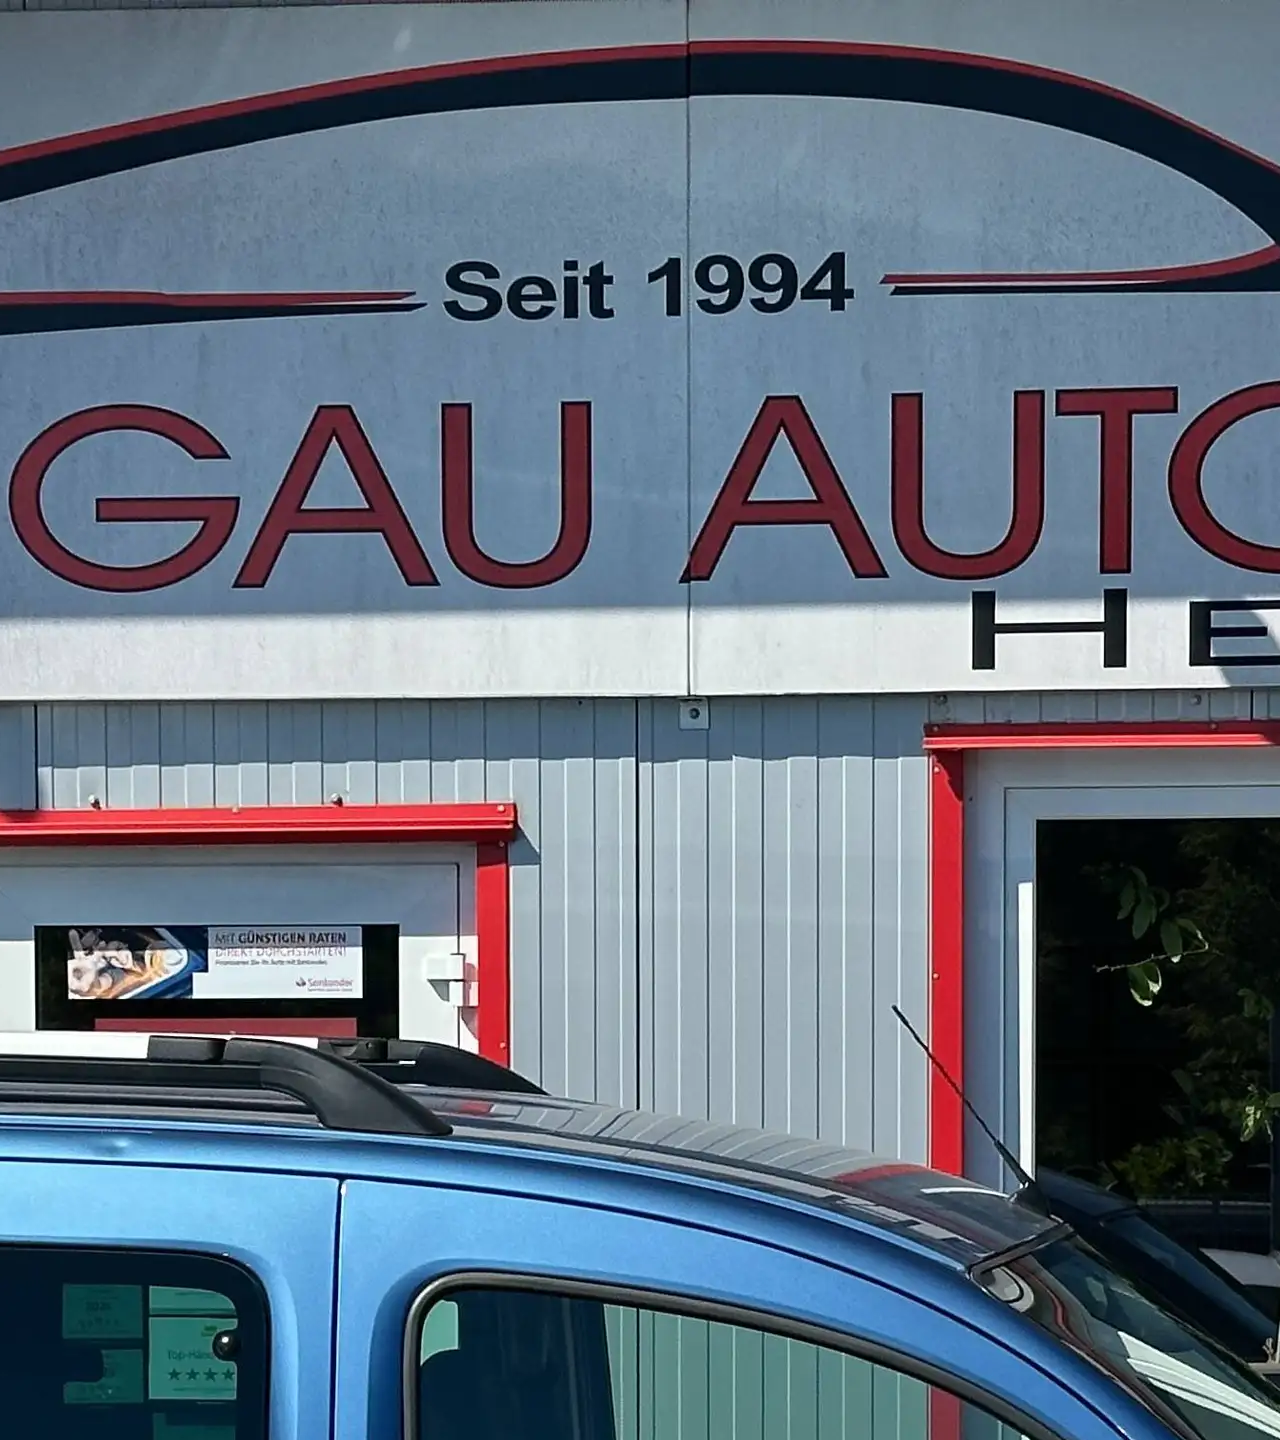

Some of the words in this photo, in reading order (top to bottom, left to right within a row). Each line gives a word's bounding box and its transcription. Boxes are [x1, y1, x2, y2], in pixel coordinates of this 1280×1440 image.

[443, 259, 615, 322] Seit
[646, 251, 855, 318] 1994
[215, 931, 234, 944] MIT
[238, 929, 305, 944] GÜNSTIGEN
[308, 931, 347, 944] RATEN
[215, 946, 253, 958] DIREKT
[307, 976, 353, 988] Santander
